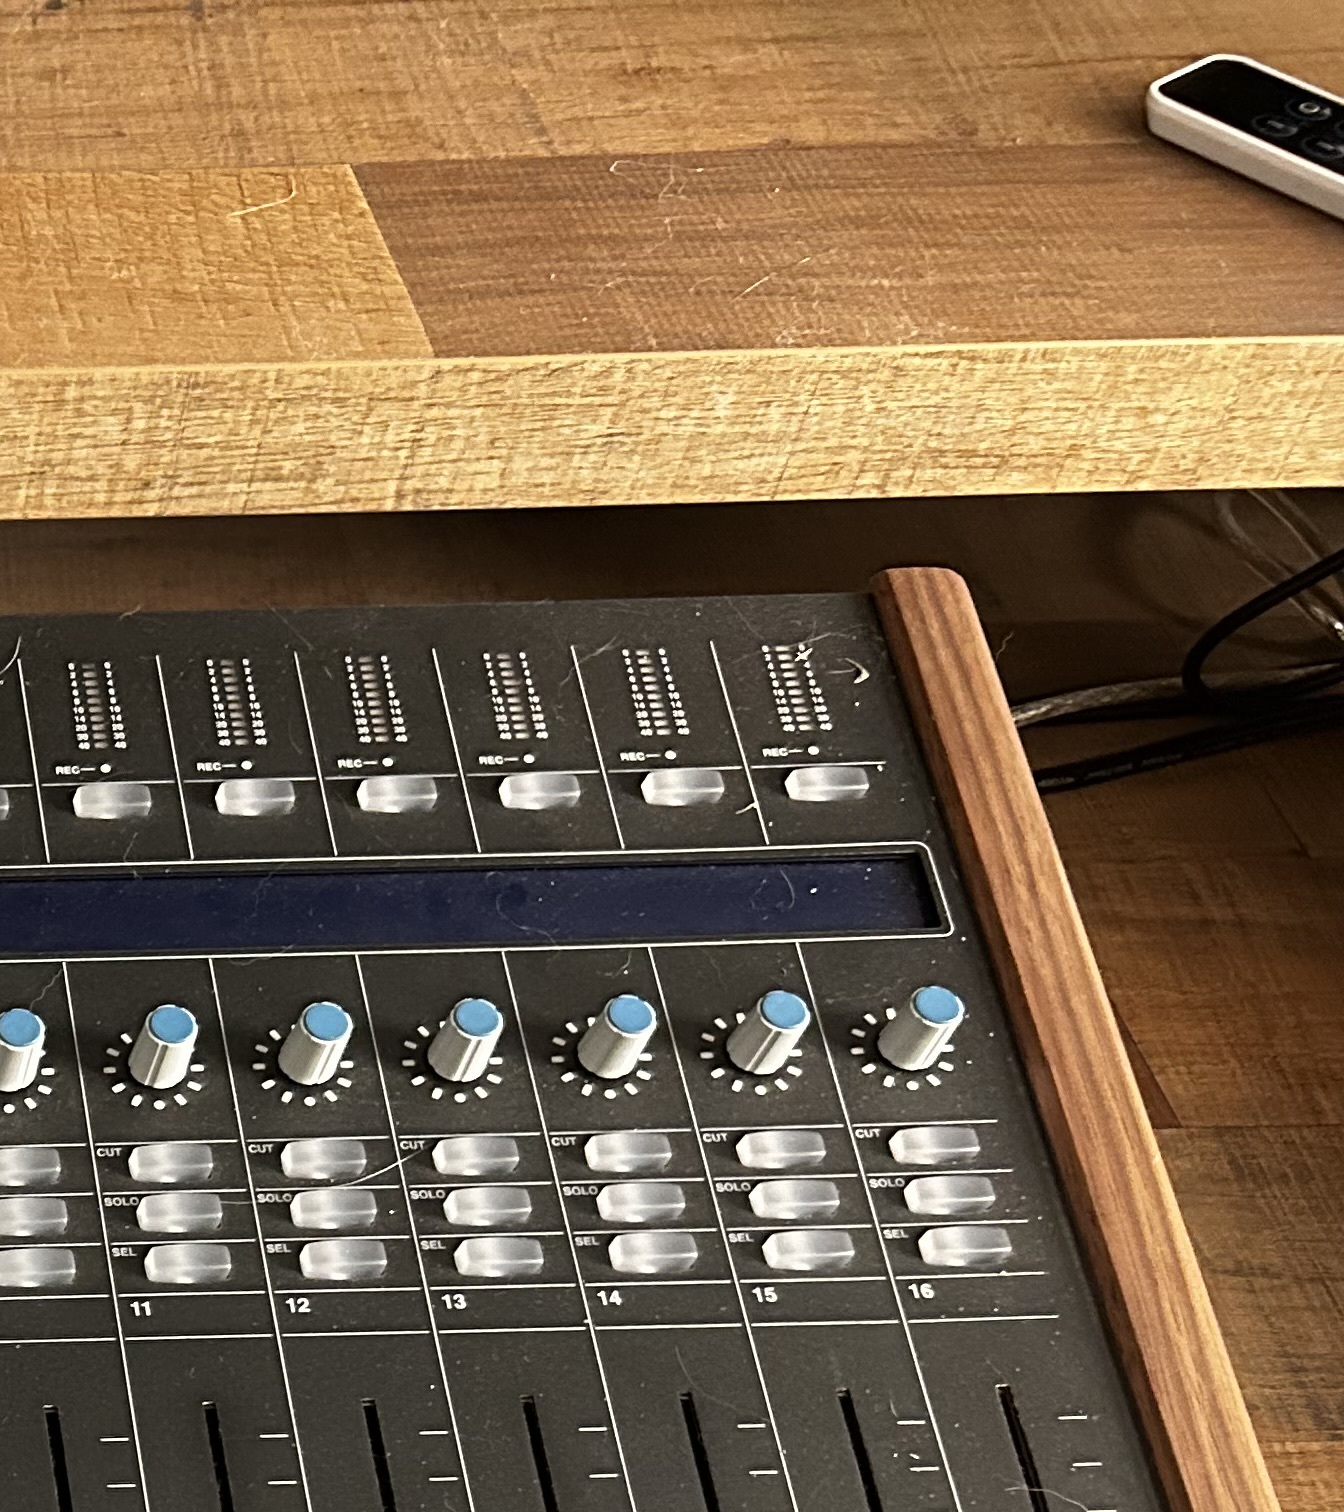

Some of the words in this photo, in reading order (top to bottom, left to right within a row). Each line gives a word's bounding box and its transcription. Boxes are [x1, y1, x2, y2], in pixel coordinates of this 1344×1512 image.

[620, 752, 645, 761] REC
[763, 748, 787, 757] REC
[337, 759, 361, 769] REC
[479, 755, 503, 765] REC
[56, 765, 80, 774] REC
[197, 762, 220, 771] REC
[703, 1133, 728, 1143] CUT
[856, 1129, 881, 1139] CUT
[400, 1141, 425, 1150] CUT
[552, 1137, 576, 1146] CUT
[96, 1147, 122, 1157] CUT
[249, 1144, 273, 1154] CUT
[716, 1182, 751, 1192] SOLO
[870, 1178, 905, 1188] SOLO
[410, 1189, 445, 1199] SOLO
[563, 1186, 598, 1196] SOLO
[104, 1197, 139, 1207] SOLO
[257, 1193, 292, 1203] SOLO
[729, 1233, 754, 1243] SEL
[883, 1229, 909, 1239] SEL
[421, 1241, 446, 1250] SEL
[575, 1237, 600, 1246] SEL
[112, 1247, 137, 1257] SEL
[266, 1244, 291, 1253] SEL
[752, 1287, 777, 1303] 15
[908, 1284, 935, 1299] 16
[442, 1294, 467, 1309] 13
[597, 1291, 623, 1306] 14
[130, 1302, 152, 1317] 11
[286, 1298, 311, 1313] 12
